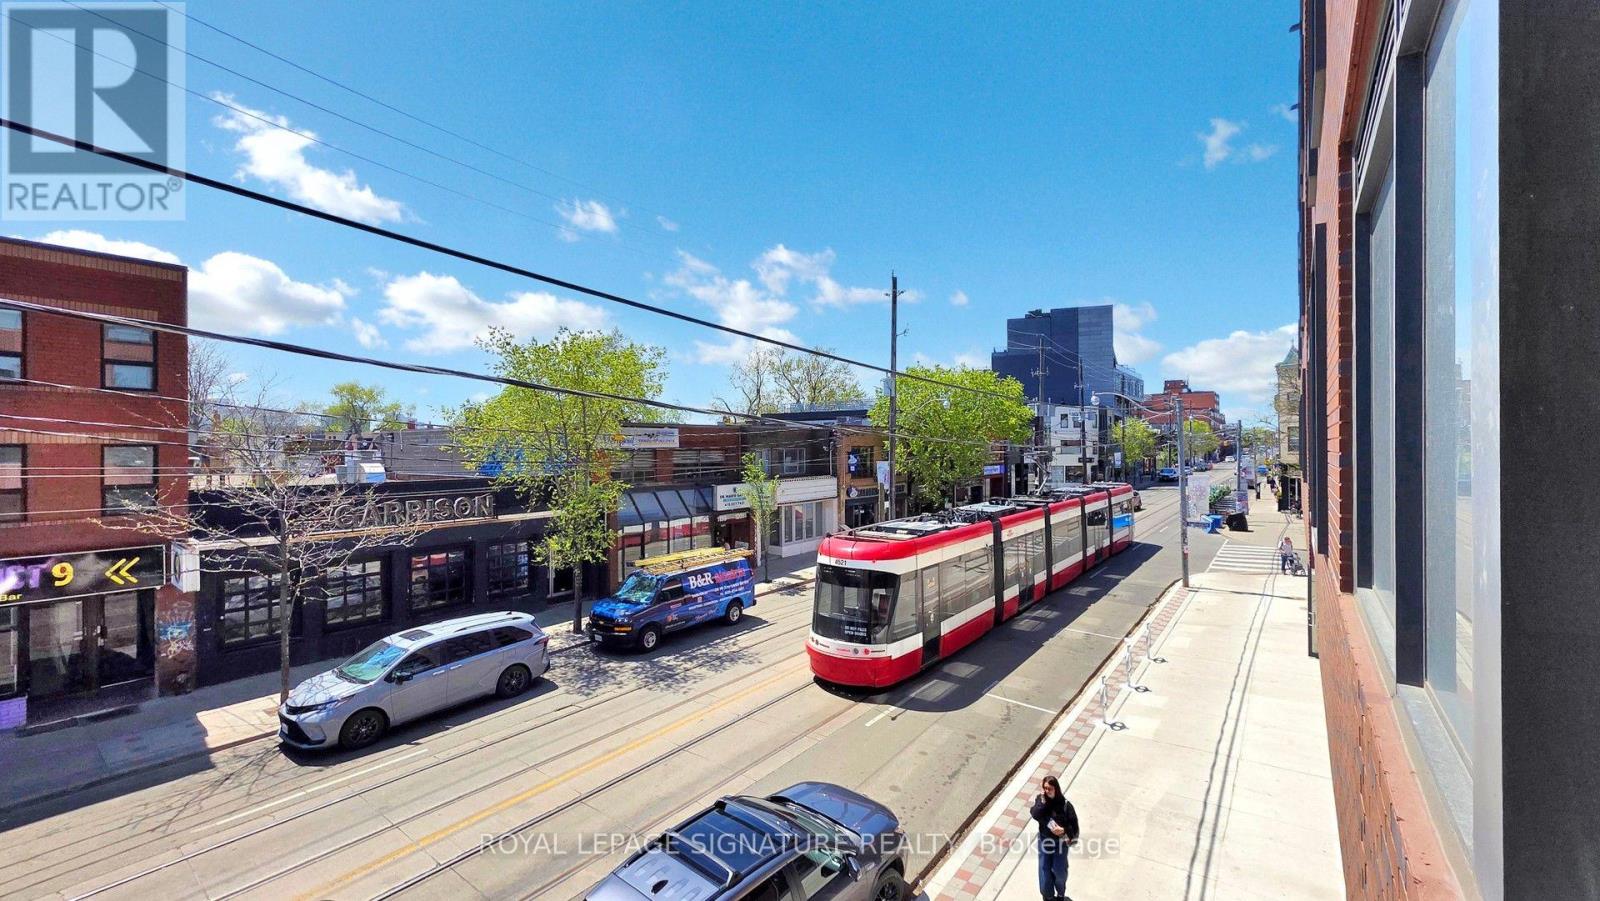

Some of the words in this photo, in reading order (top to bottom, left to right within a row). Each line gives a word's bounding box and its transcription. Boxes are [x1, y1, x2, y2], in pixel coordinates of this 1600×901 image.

[333, 494, 494, 529] GARRISON
[51, 562, 74, 587] 9
[688, 572, 714, 589] B&R
